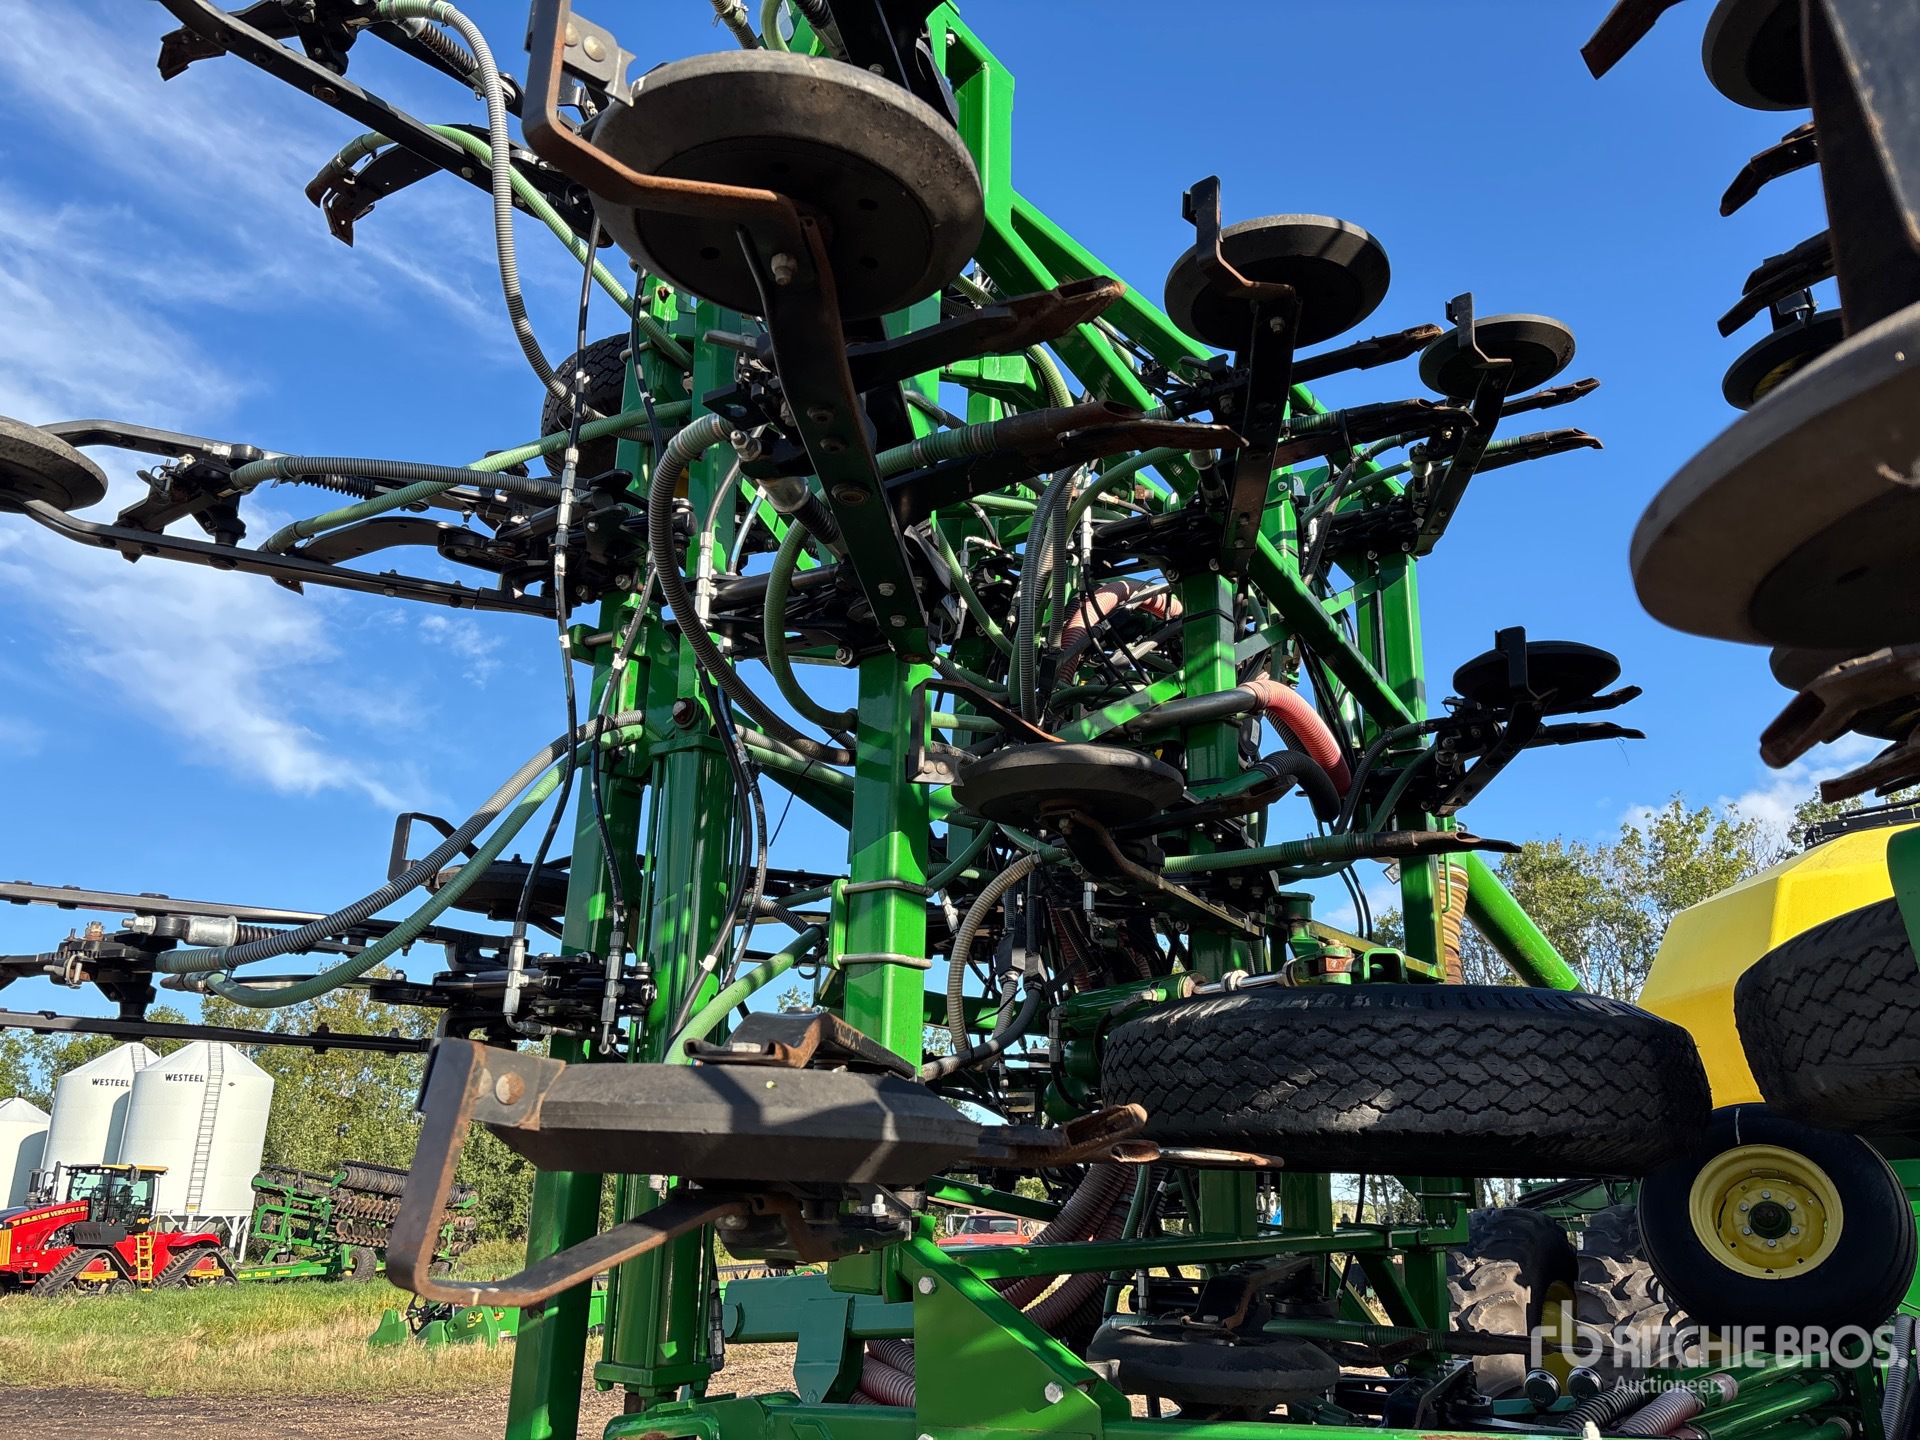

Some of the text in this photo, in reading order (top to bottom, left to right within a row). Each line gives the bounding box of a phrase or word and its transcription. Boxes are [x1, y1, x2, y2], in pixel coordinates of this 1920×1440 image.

[91, 1078, 130, 1087] WESTEEL
[164, 1073, 205, 1083] WESTEEL
[50, 1206, 80, 1217] VERSATILE
